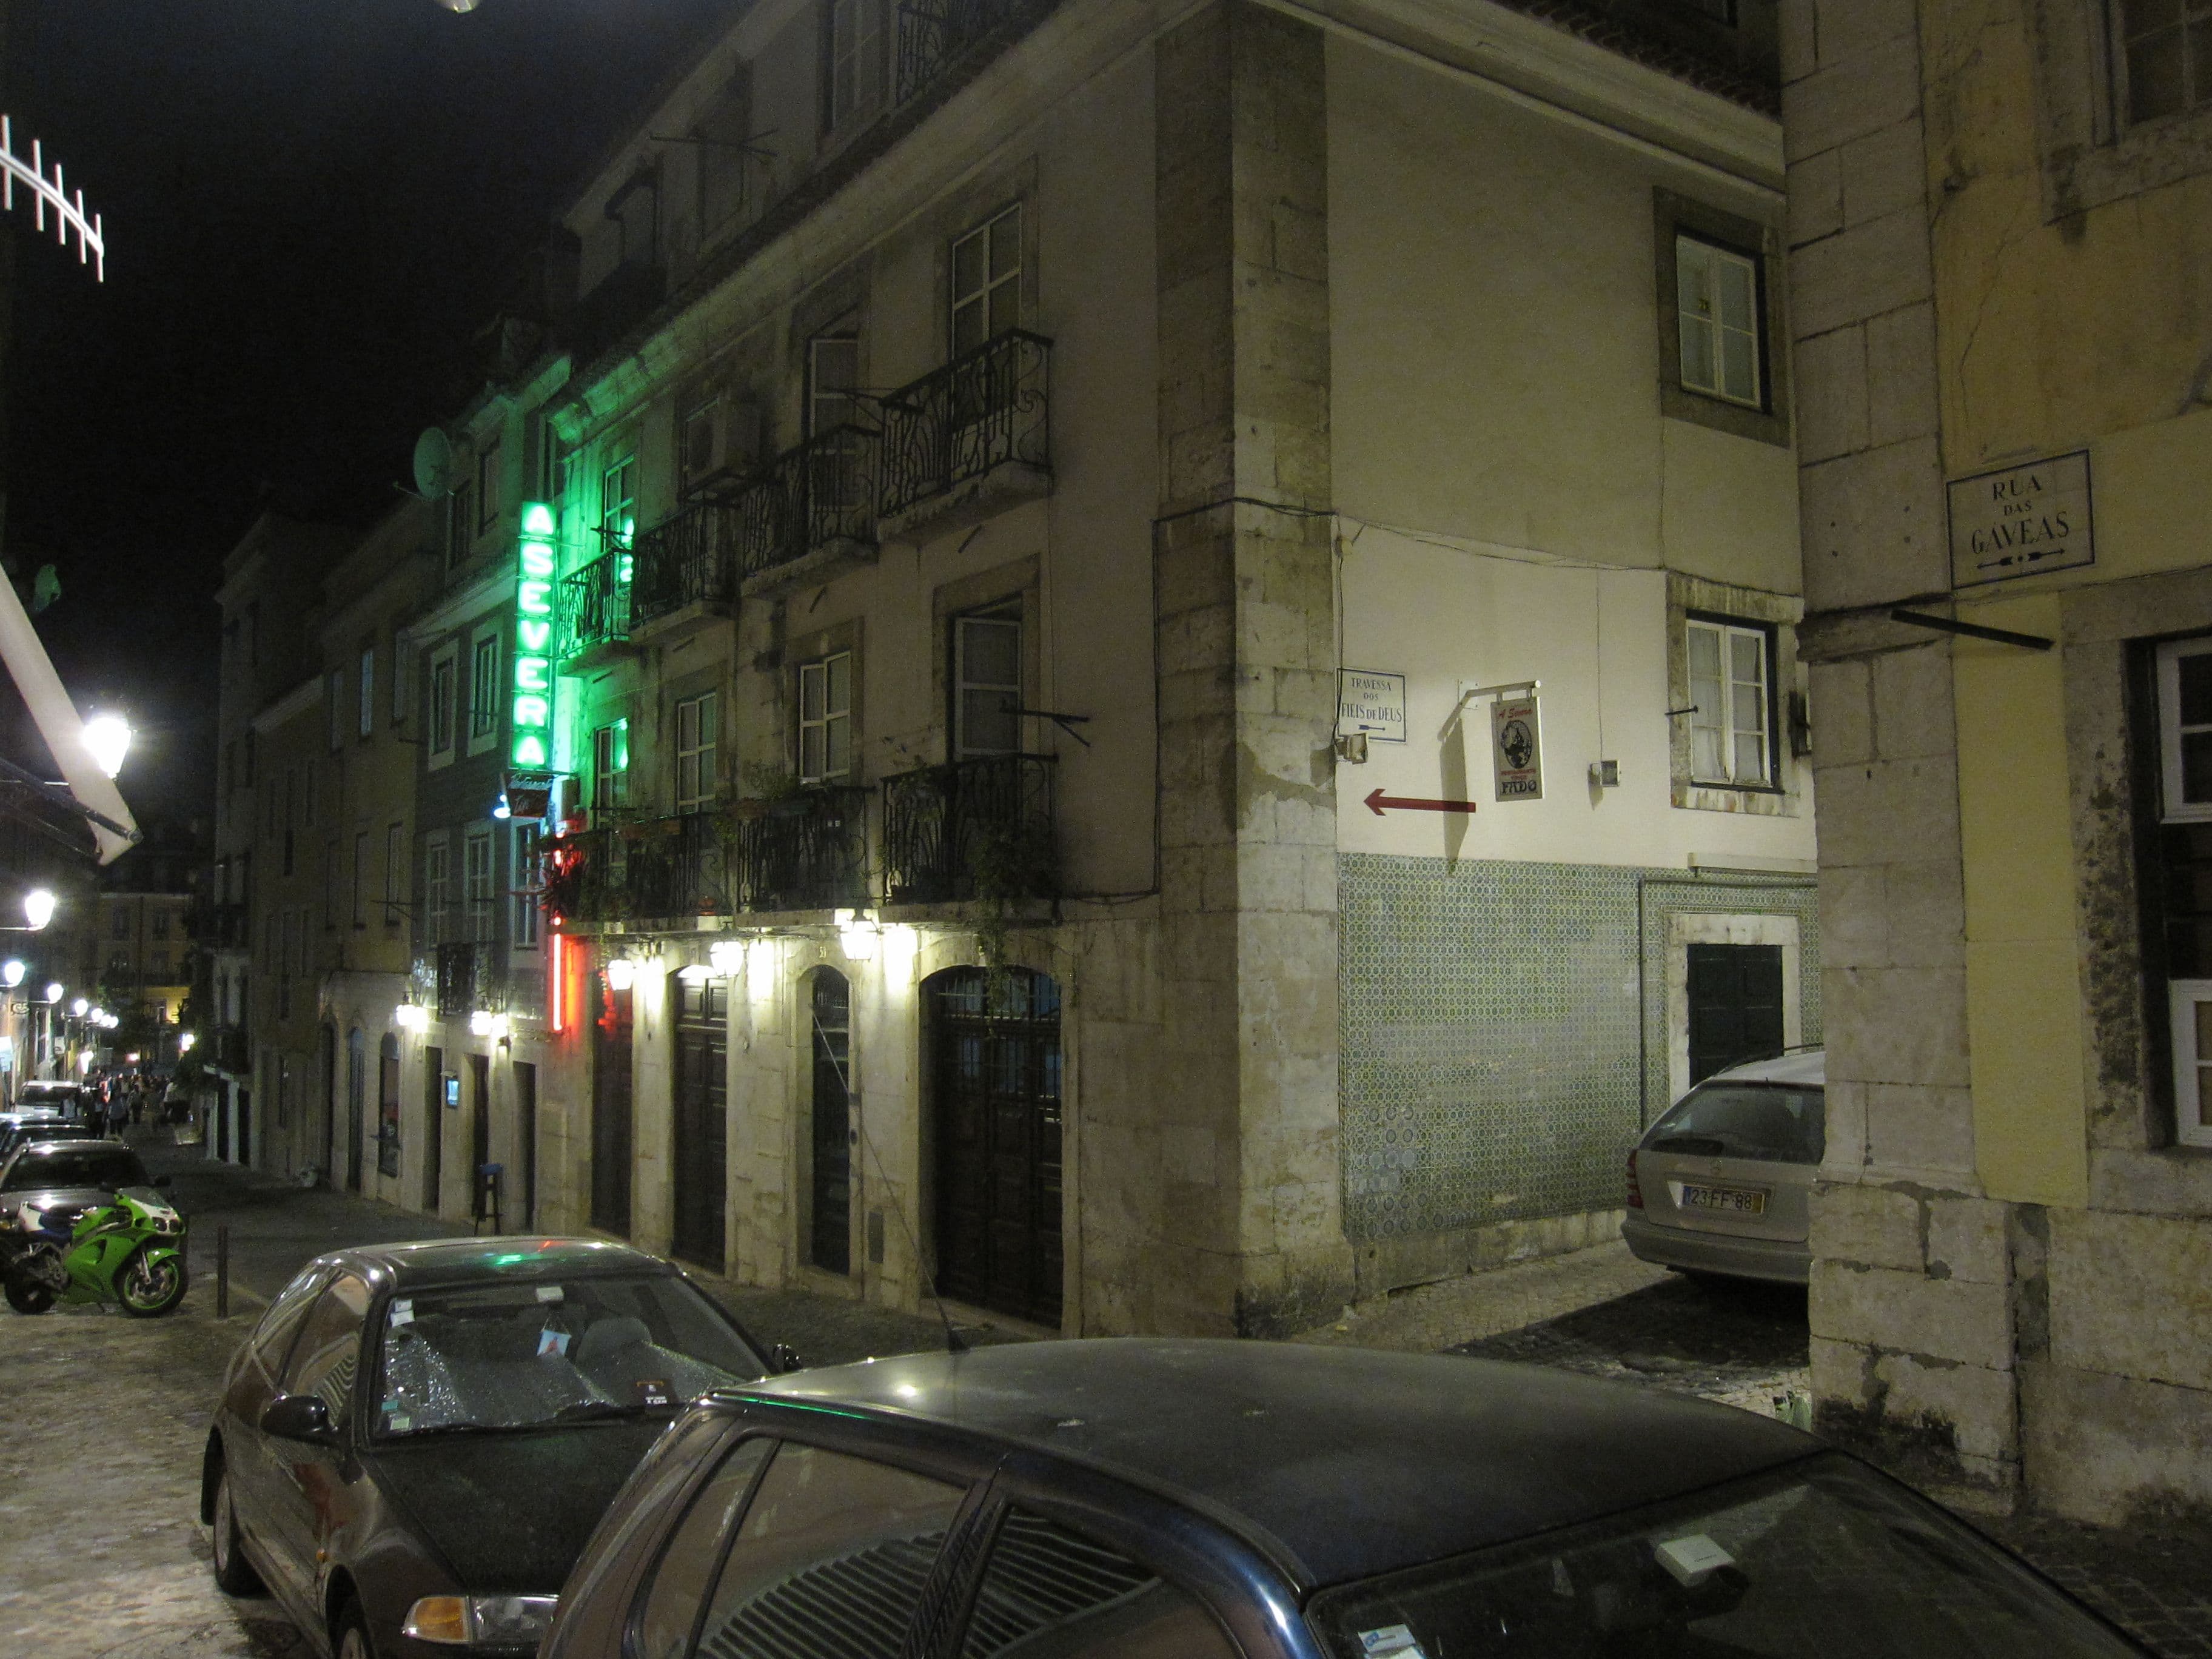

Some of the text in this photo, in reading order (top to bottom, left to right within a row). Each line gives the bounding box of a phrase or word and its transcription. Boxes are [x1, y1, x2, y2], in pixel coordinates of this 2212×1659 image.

[1993, 475, 2042, 500] RUA
[2003, 499, 2032, 515] DAS
[1351, 677, 1392, 692] TRAVESSA
[1363, 692, 1379, 701] DOS
[1366, 708, 1378, 720] DE
[1378, 706, 1403, 723] DEUS
[1501, 780, 1537, 794] FADO
